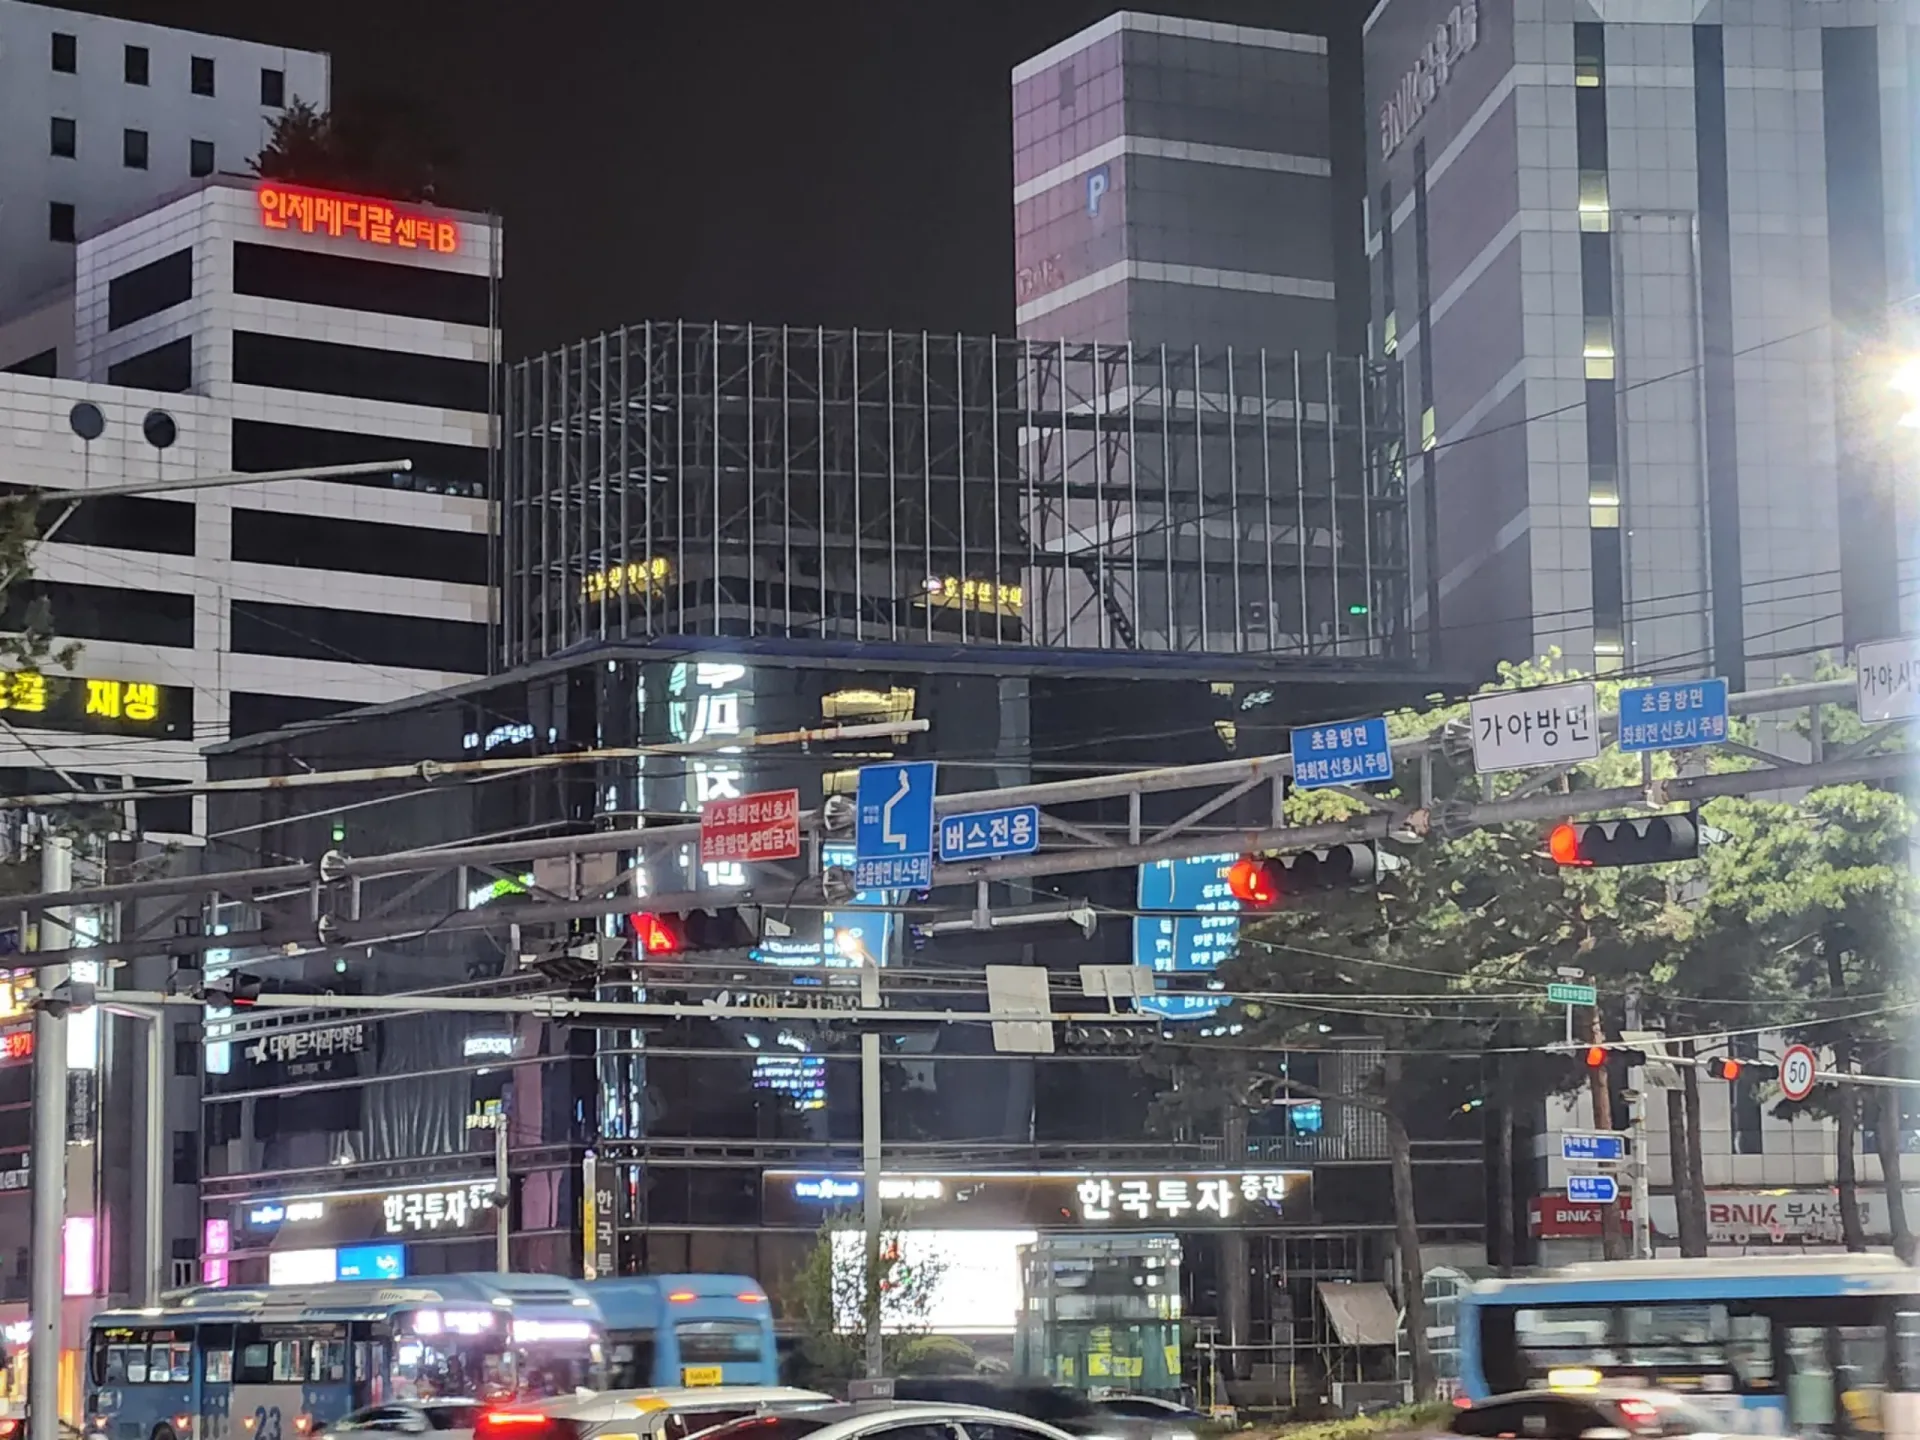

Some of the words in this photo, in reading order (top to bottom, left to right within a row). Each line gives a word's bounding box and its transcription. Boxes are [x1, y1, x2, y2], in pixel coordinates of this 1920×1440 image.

[1088, 169, 1106, 216] P
[260, 189, 394, 244] 인제메디칼
[86, 679, 157, 720] 재생
[1642, 687, 1703, 714] 초읍방면
[1311, 725, 1368, 750] 초읍방면
[1479, 704, 1589, 746] 가야방면
[1660, 717, 1697, 742] 신호시
[1330, 755, 1364, 778] 신호시
[946, 814, 1032, 852] 버스전용
[1788, 1061, 1807, 1084] 50
[384, 1190, 468, 1233] 한국투자
[1077, 1179, 1234, 1219] 한국투자
[1240, 1175, 1286, 1201] 증권
[1710, 1203, 1777, 1226] BNK
[253, 1405, 283, 1440] 23
